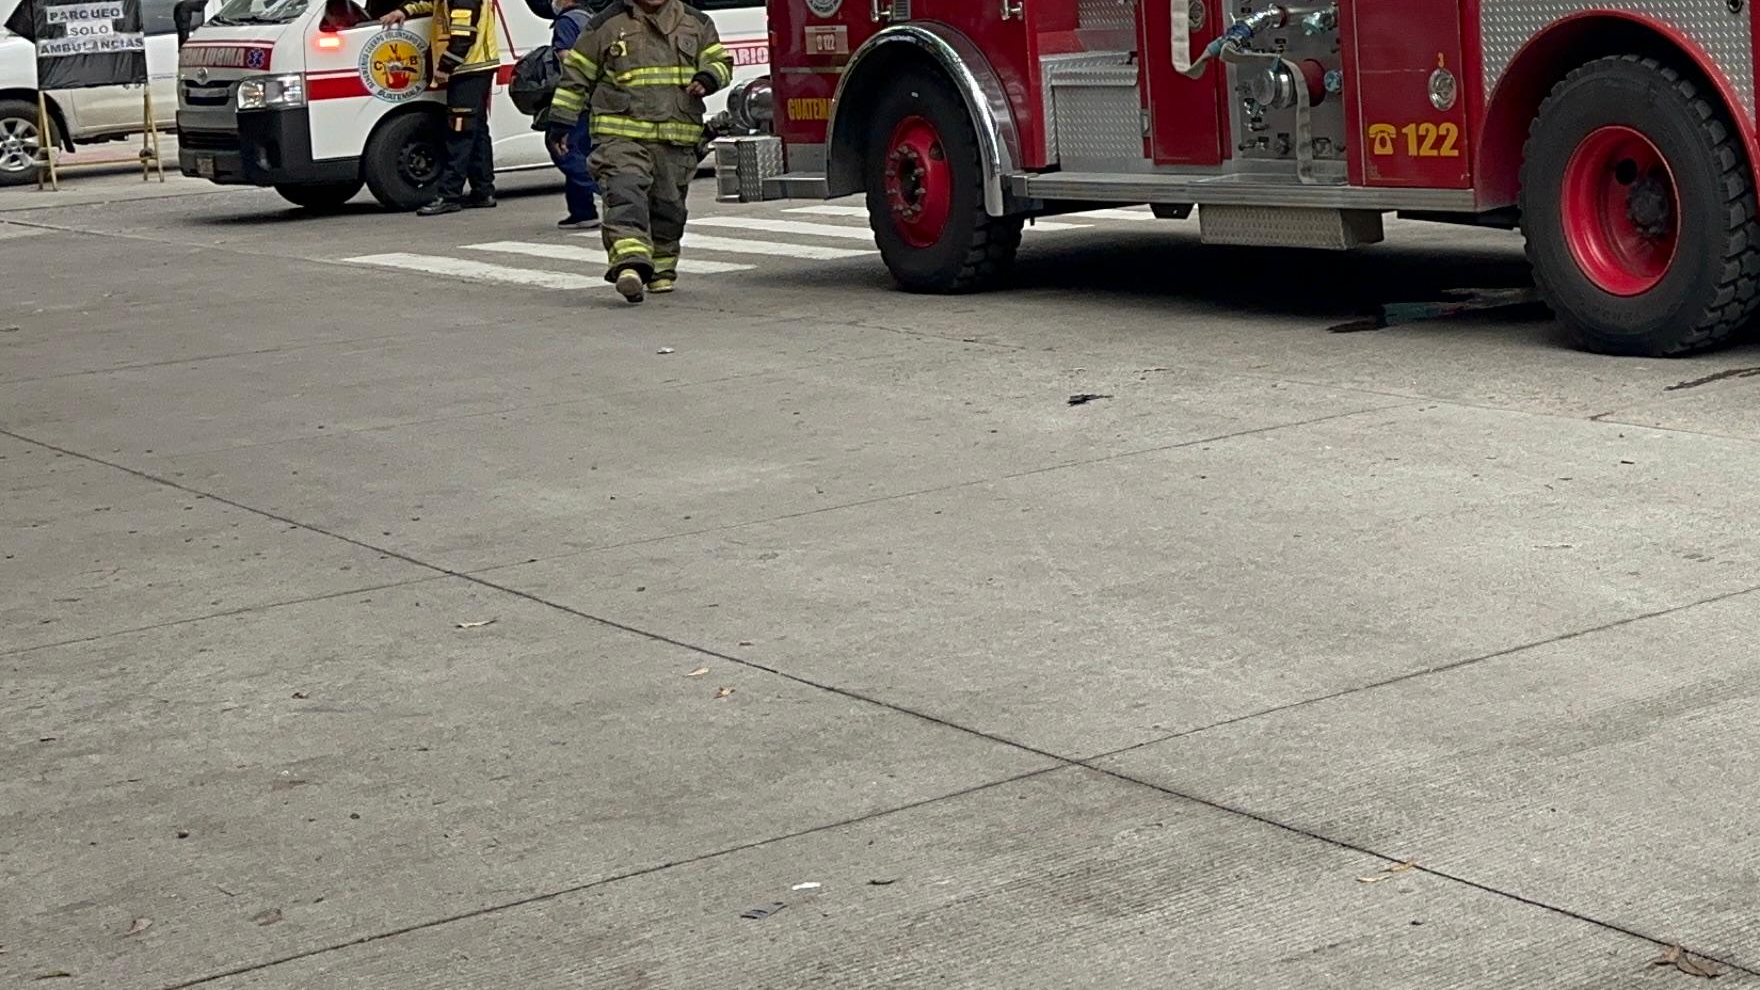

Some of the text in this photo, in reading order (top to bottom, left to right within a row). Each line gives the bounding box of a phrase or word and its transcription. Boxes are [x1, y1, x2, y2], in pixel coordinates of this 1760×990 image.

[49, 7, 121, 22] PARQUEO
[69, 24, 109, 37] SOLO
[39, 36, 145, 55] AMBULANCIAS
[1402, 122, 1459, 157] 122
